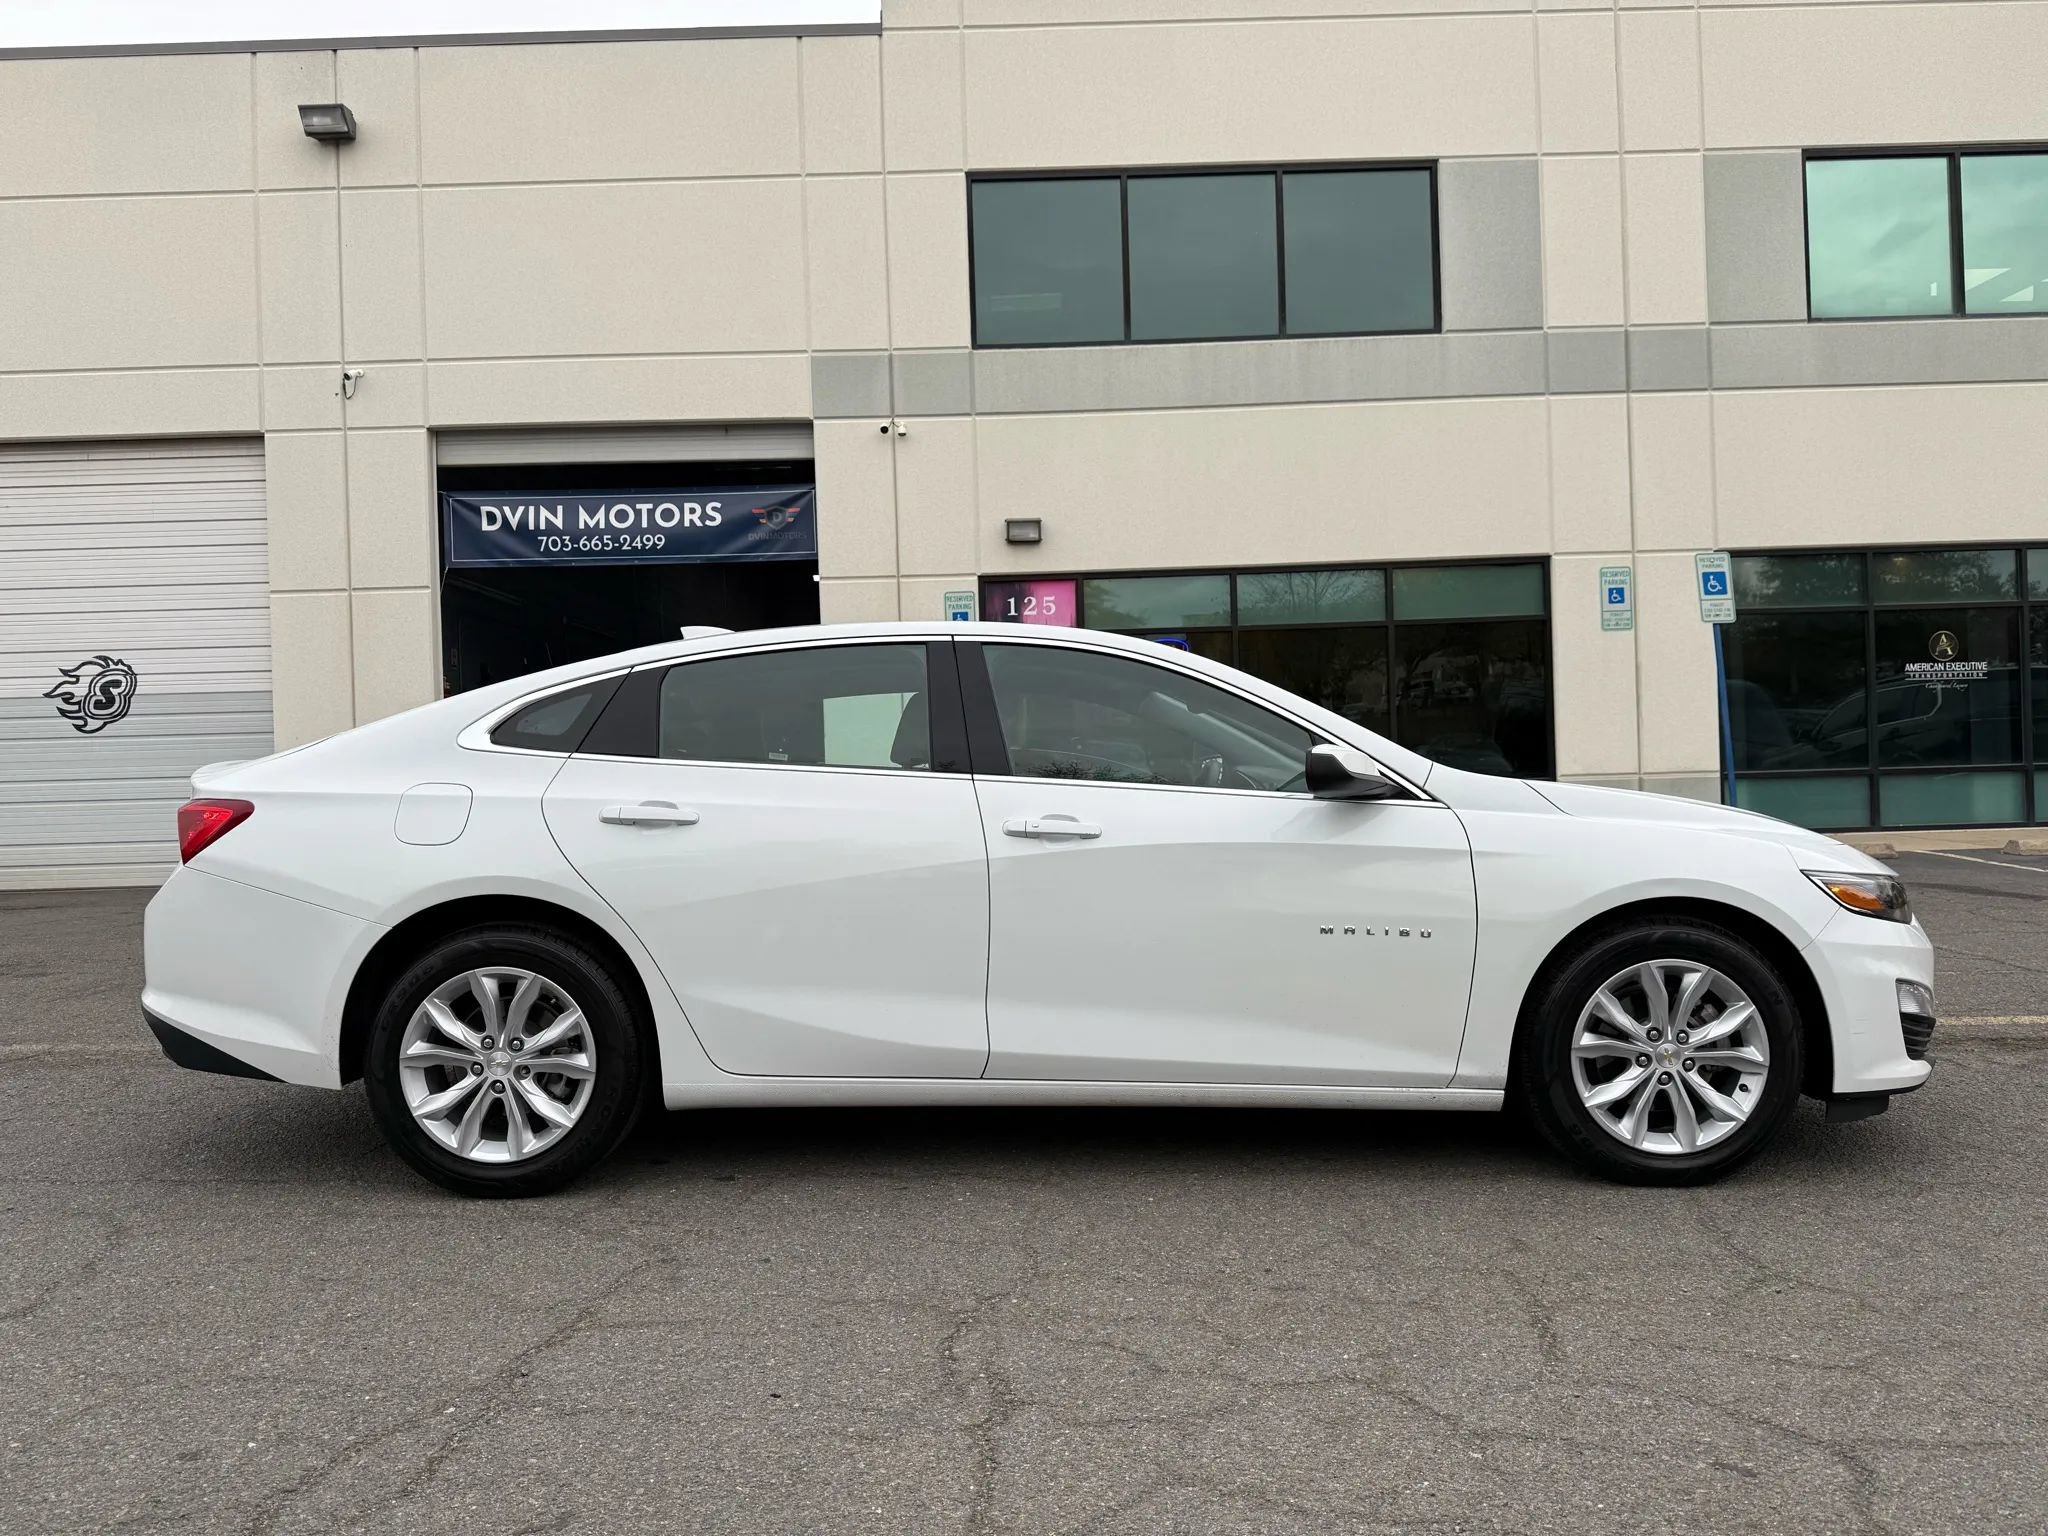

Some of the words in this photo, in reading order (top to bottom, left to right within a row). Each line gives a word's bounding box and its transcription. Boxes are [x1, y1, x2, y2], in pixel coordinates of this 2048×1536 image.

[480, 505, 564, 531] DVIN
[578, 502, 723, 529] MOTORS
[537, 534, 666, 552] 703-665-2499
[1007, 596, 1056, 616] 125
[1904, 663, 1945, 672] AMERICAN
[1946, 661, 1988, 671] EXECUTIVE
[1320, 925, 1432, 938] MALIBU
